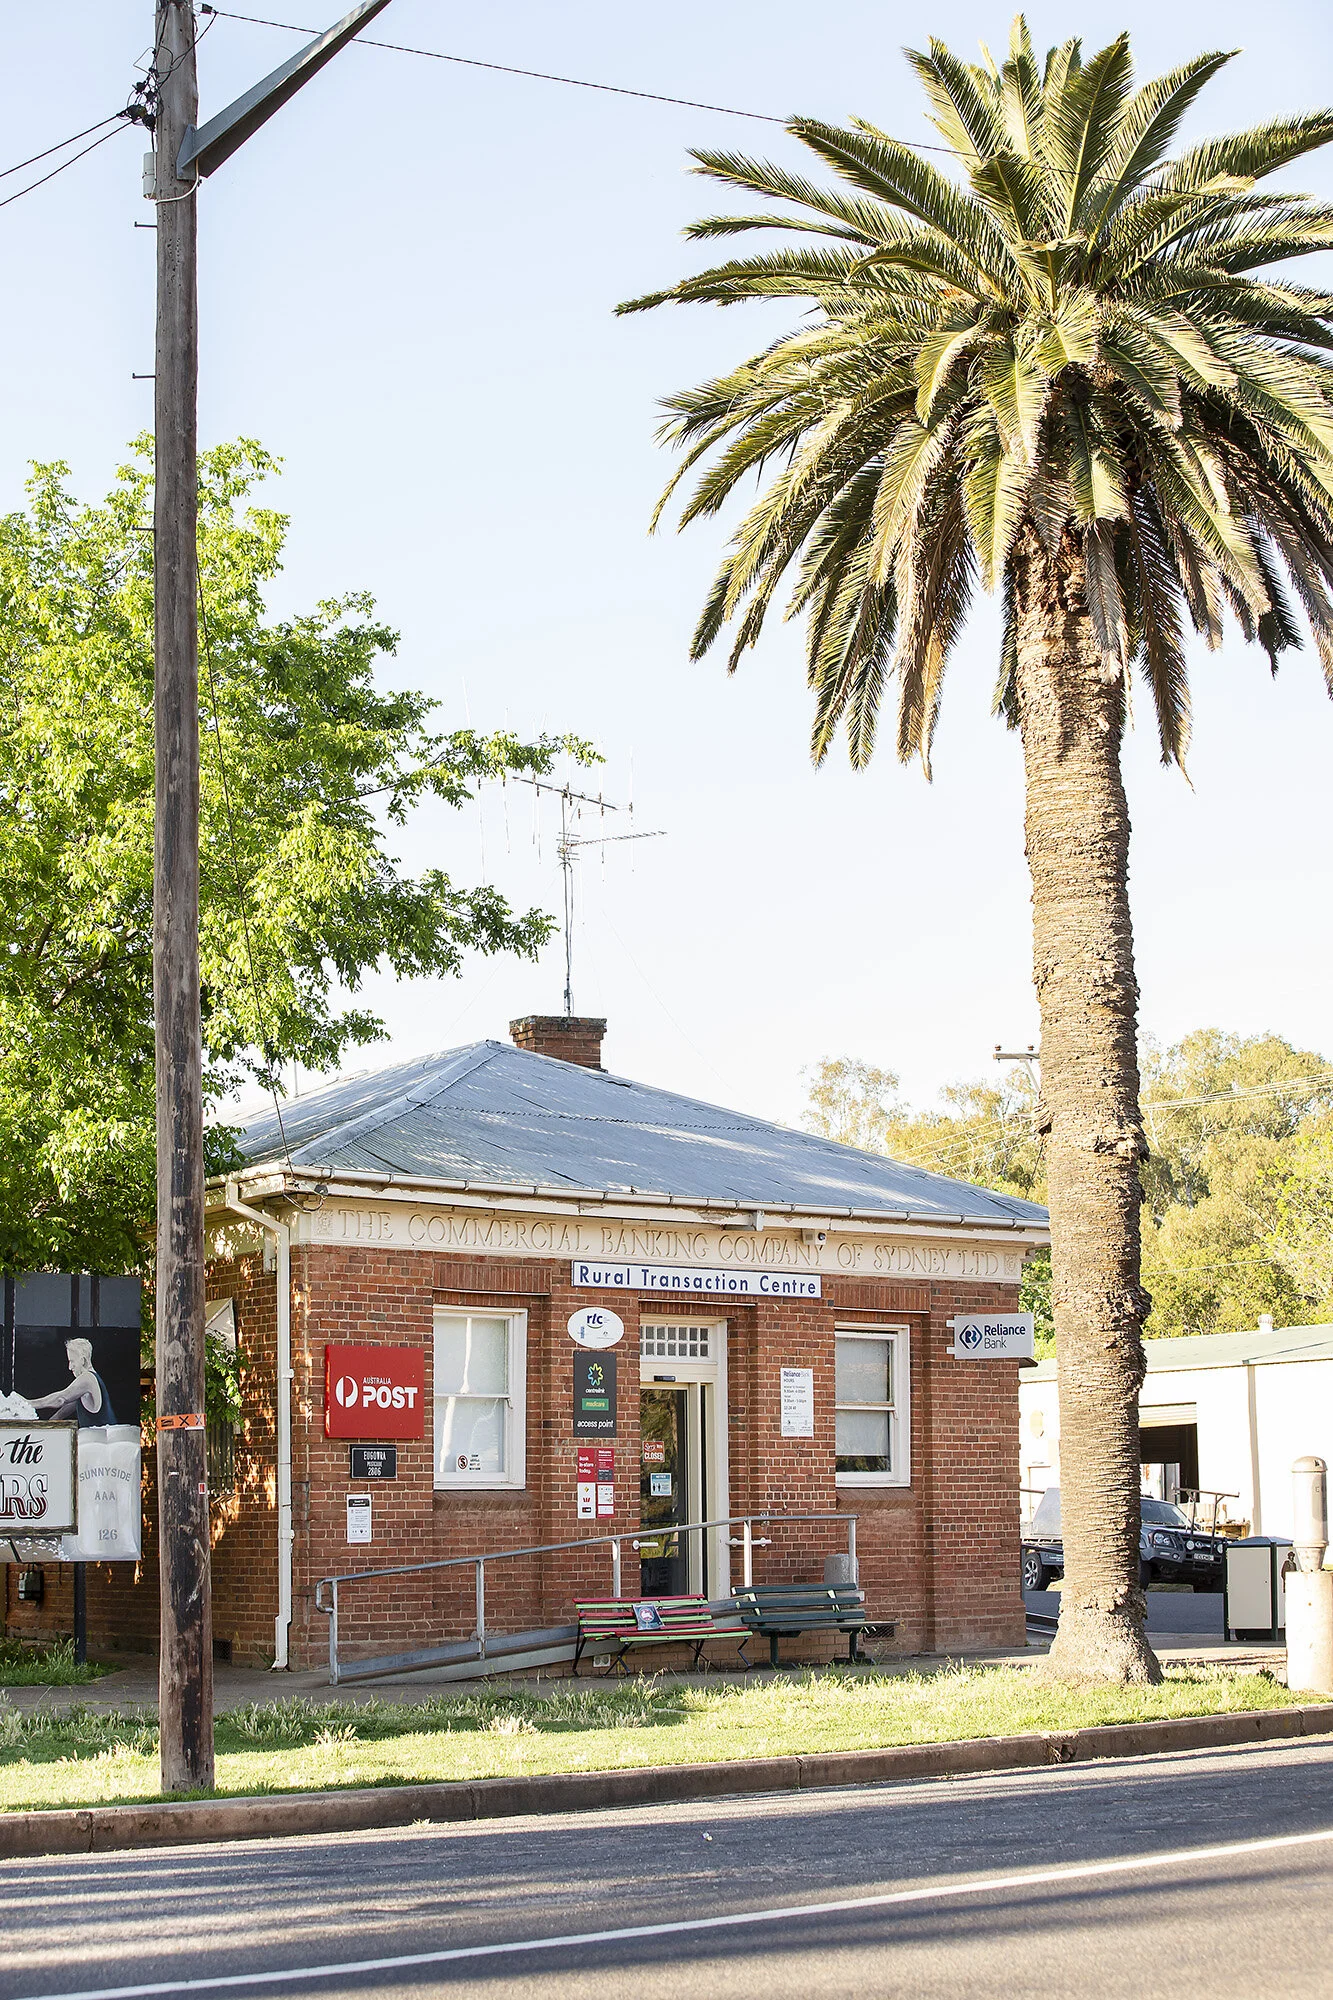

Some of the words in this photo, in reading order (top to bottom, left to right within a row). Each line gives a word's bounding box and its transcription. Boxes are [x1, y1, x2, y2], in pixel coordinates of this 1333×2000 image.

[338, 1209, 394, 1241] THE
[408, 1213, 591, 1252] COMMERCIAL
[601, 1227, 710, 1260] BANKING
[718, 1233, 824, 1267] COMPANY
[837, 1241, 864, 1269] OF
[873, 1243, 952, 1274] SYDNEY
[580, 1265, 631, 1285] Rural
[641, 1268, 749, 1292] Transaction
[759, 1275, 817, 1294] Centre
[586, 1313, 603, 1324] rtc
[984, 1323, 1026, 1337] Reliance
[984, 1336, 1007, 1349] Bank
[362, 1377, 392, 1385] AUSTRALIA
[362, 1386, 418, 1409] POST
[577, 1420, 598, 1428] access
[598, 1419, 614, 1430] point
[5, 1433, 45, 1465] the
[79, 1467, 132, 1482] SUNNYSIDE
[0, 1473, 48, 1520] RS
[94, 1490, 116, 1501] AAA
[99, 1528, 118, 1541] 126
